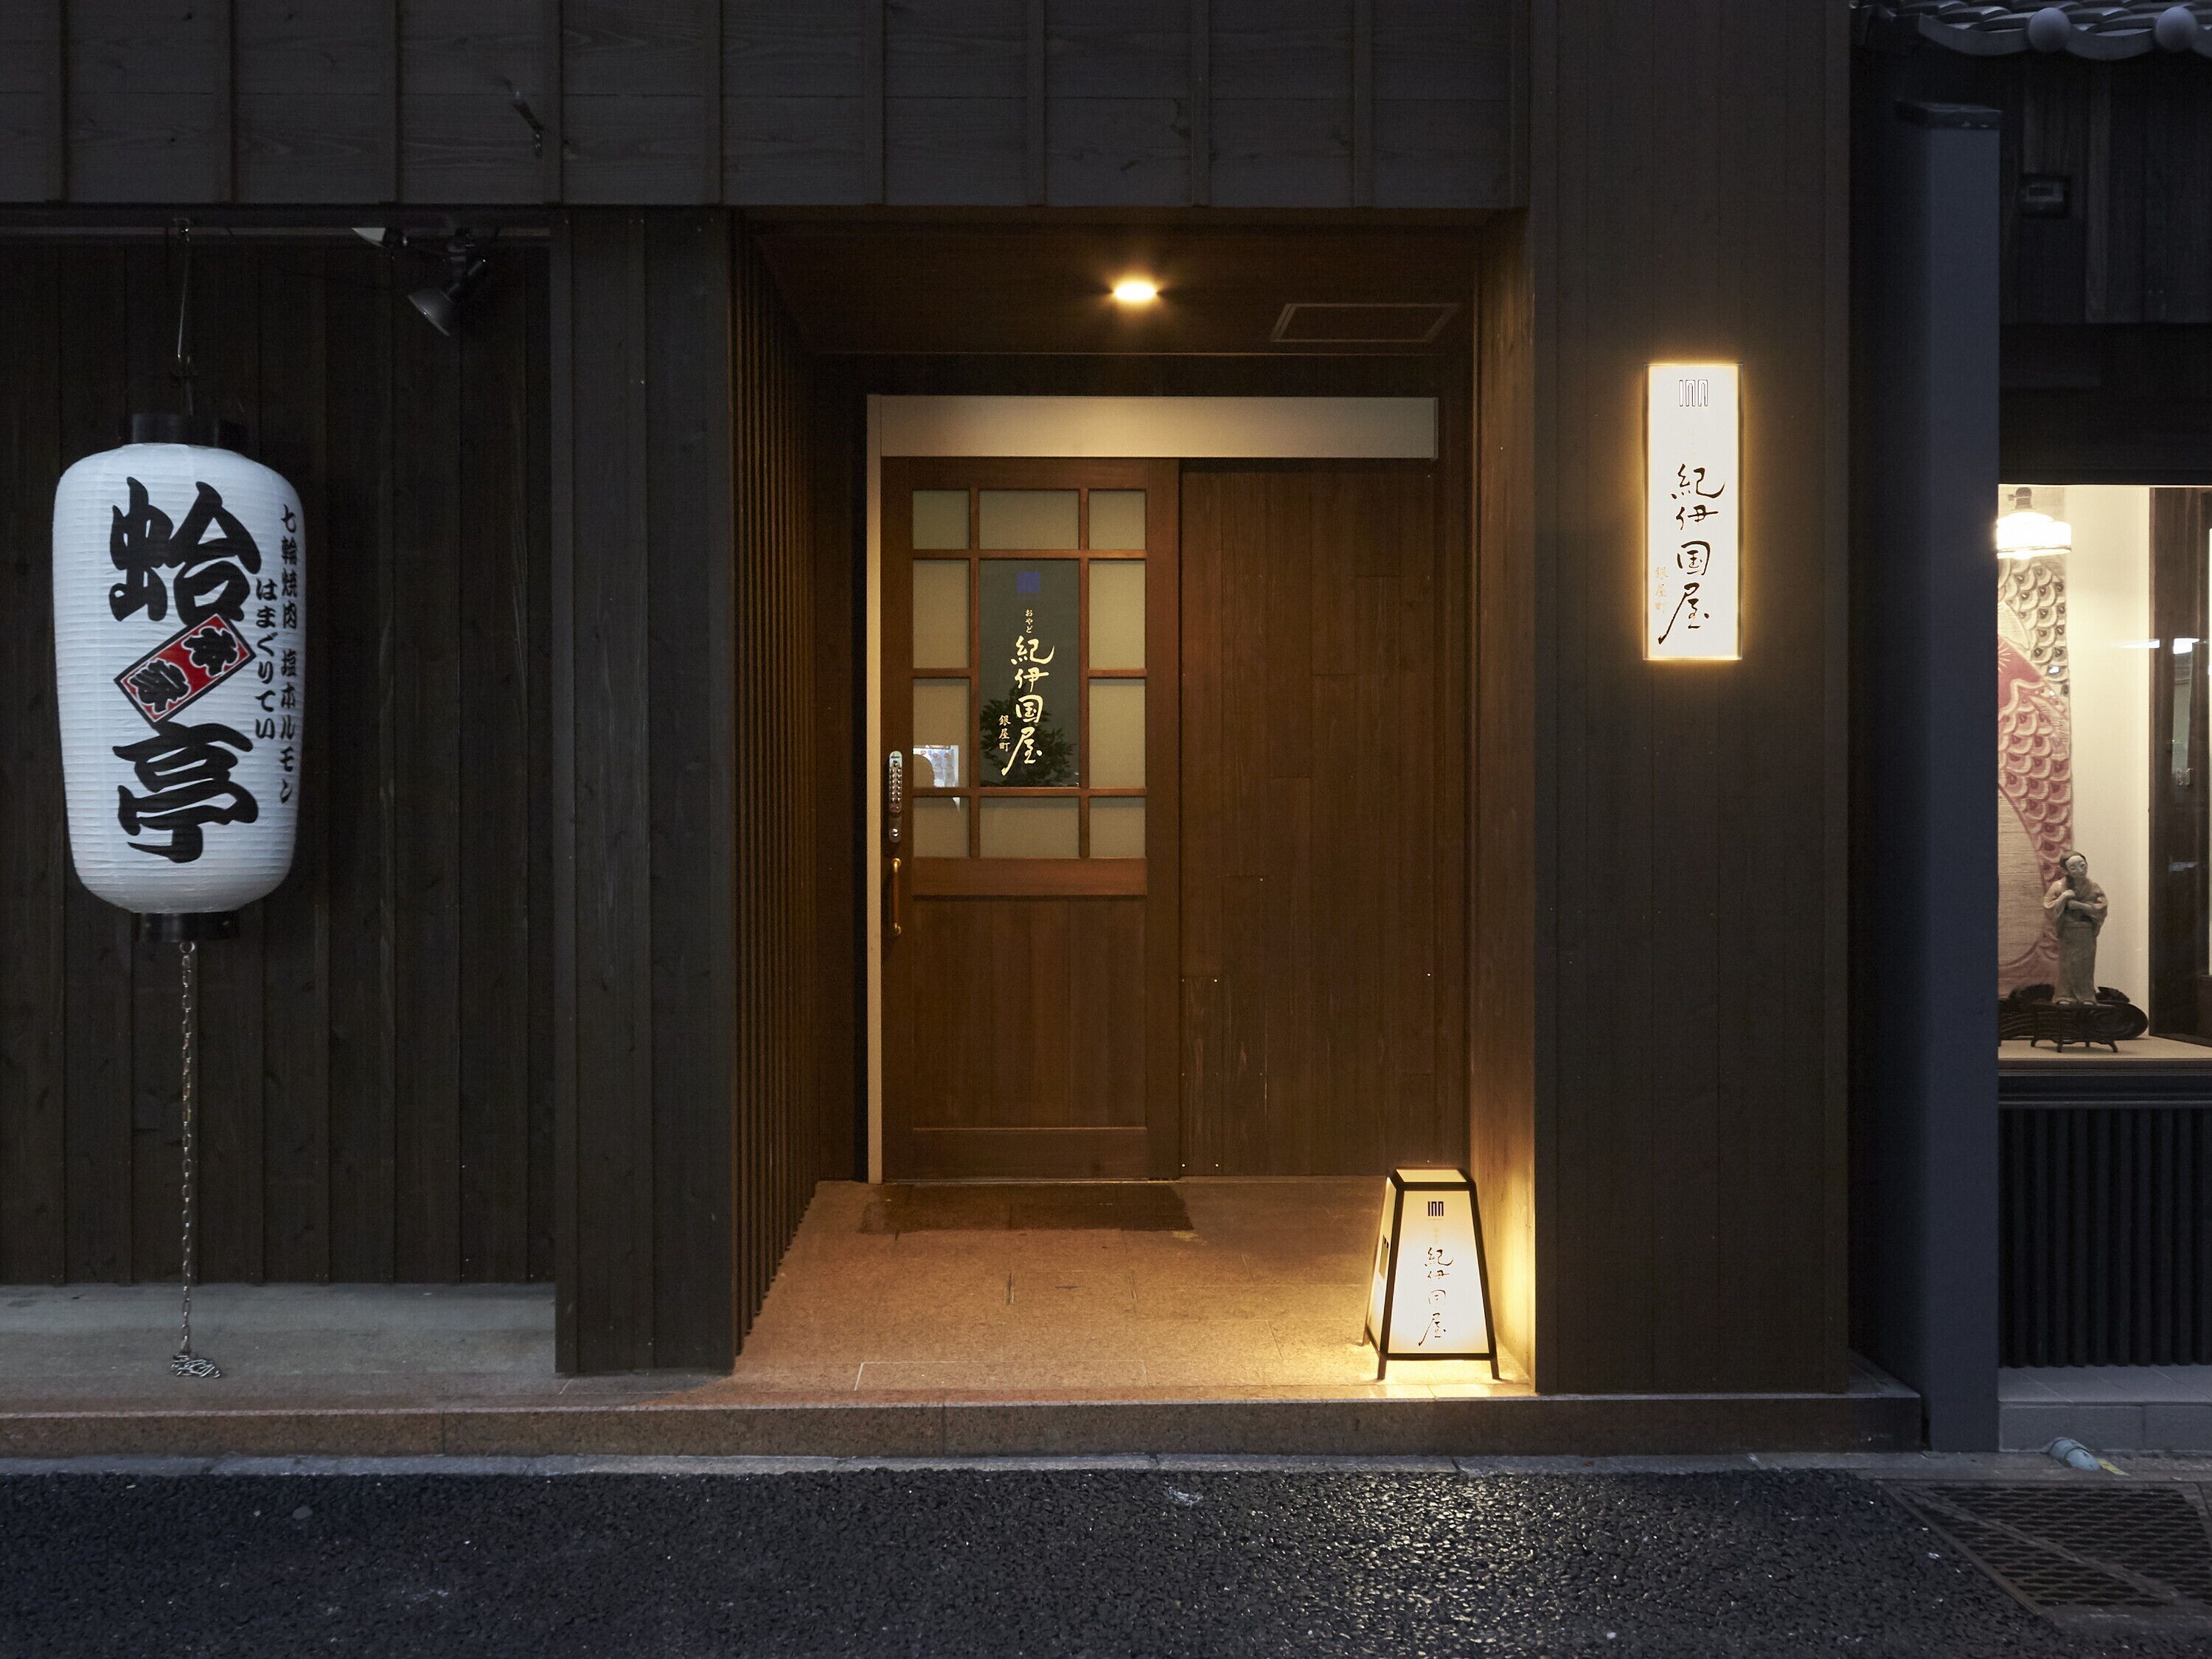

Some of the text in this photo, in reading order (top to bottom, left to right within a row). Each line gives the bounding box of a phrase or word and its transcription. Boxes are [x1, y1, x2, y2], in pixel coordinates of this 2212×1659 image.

[281, 504, 298, 629] 七輪焼肉
[1658, 463, 1725, 645] 紀伊国屋
[255, 577, 278, 740] はまぐりてい
[1025, 609, 1034, 633] おやど
[998, 714, 1012, 752] 銀屋町
[1001, 635, 1055, 776] 紀伊国屋
[1418, 1247, 1453, 1346] 紀伊国屋
